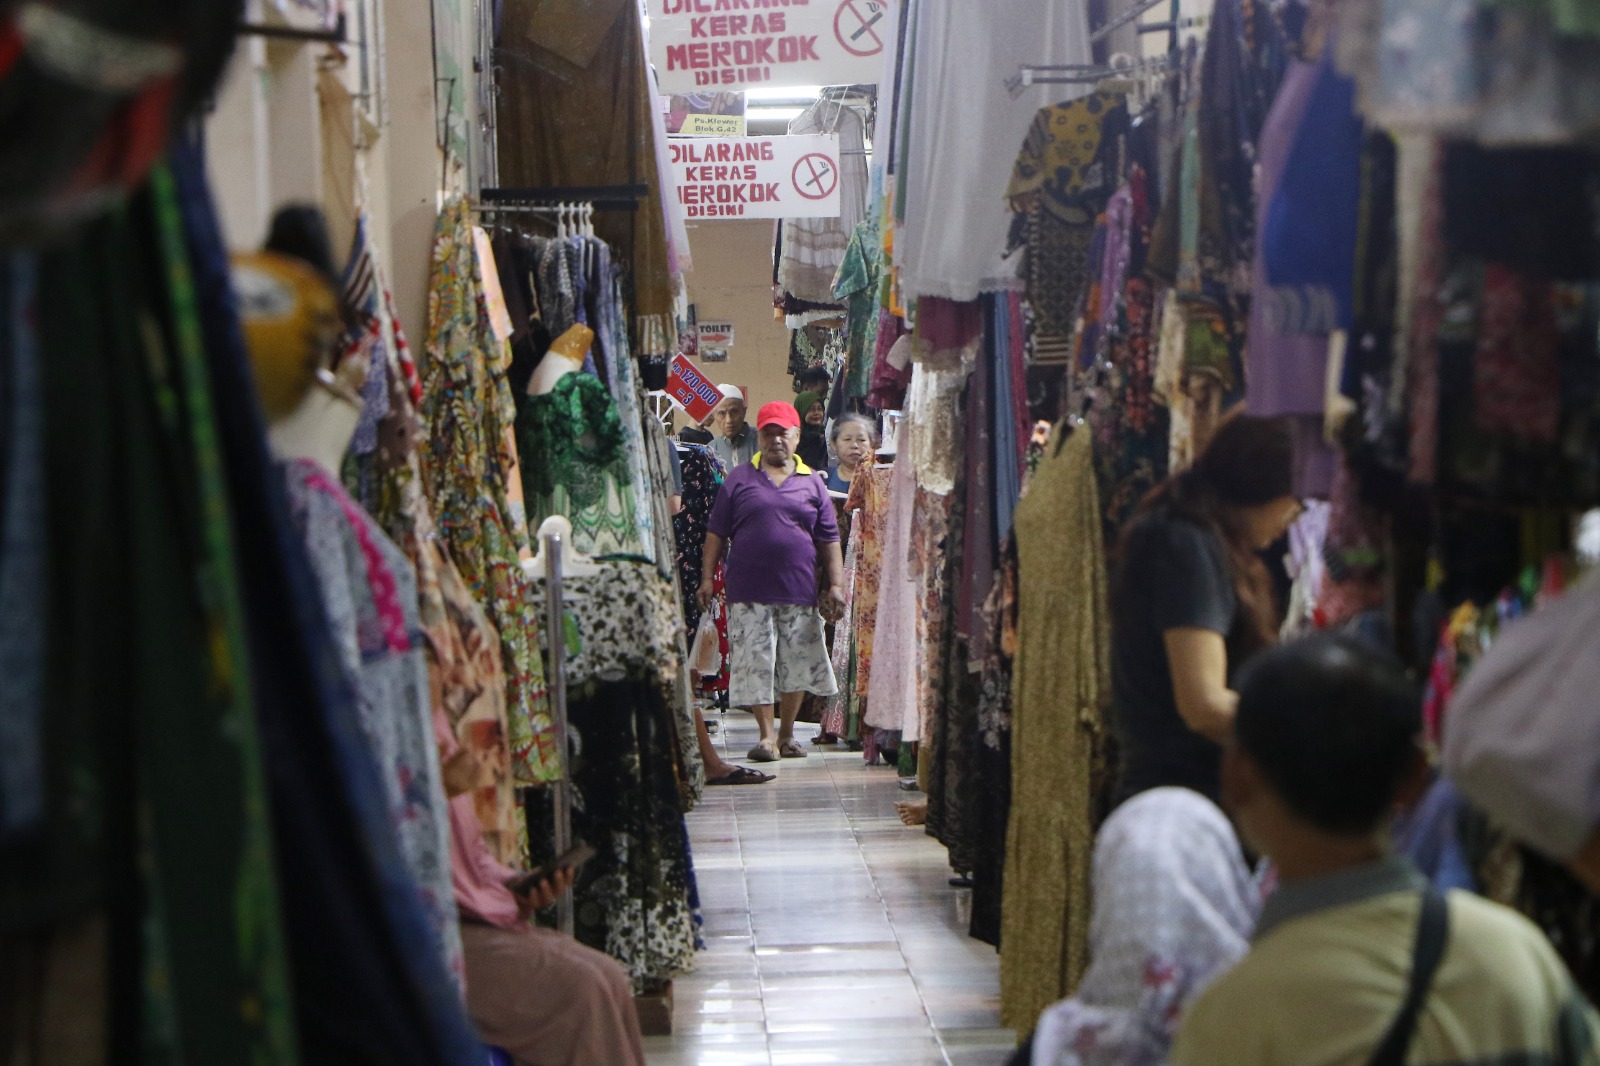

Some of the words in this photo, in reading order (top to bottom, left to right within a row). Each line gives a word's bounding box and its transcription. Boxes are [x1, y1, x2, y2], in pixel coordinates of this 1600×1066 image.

[690, 12, 786, 38] KERAS
[666, 35, 820, 71] MEROKOK
[695, 66, 771, 86] DISINI
[669, 142, 774, 163] DILARANG
[686, 165, 757, 181] KERAS
[687, 204, 744, 217] DISINI
[699, 324, 732, 333] TOILET
[680, 368, 719, 406] 120.000
[682, 393, 694, 405] 3
